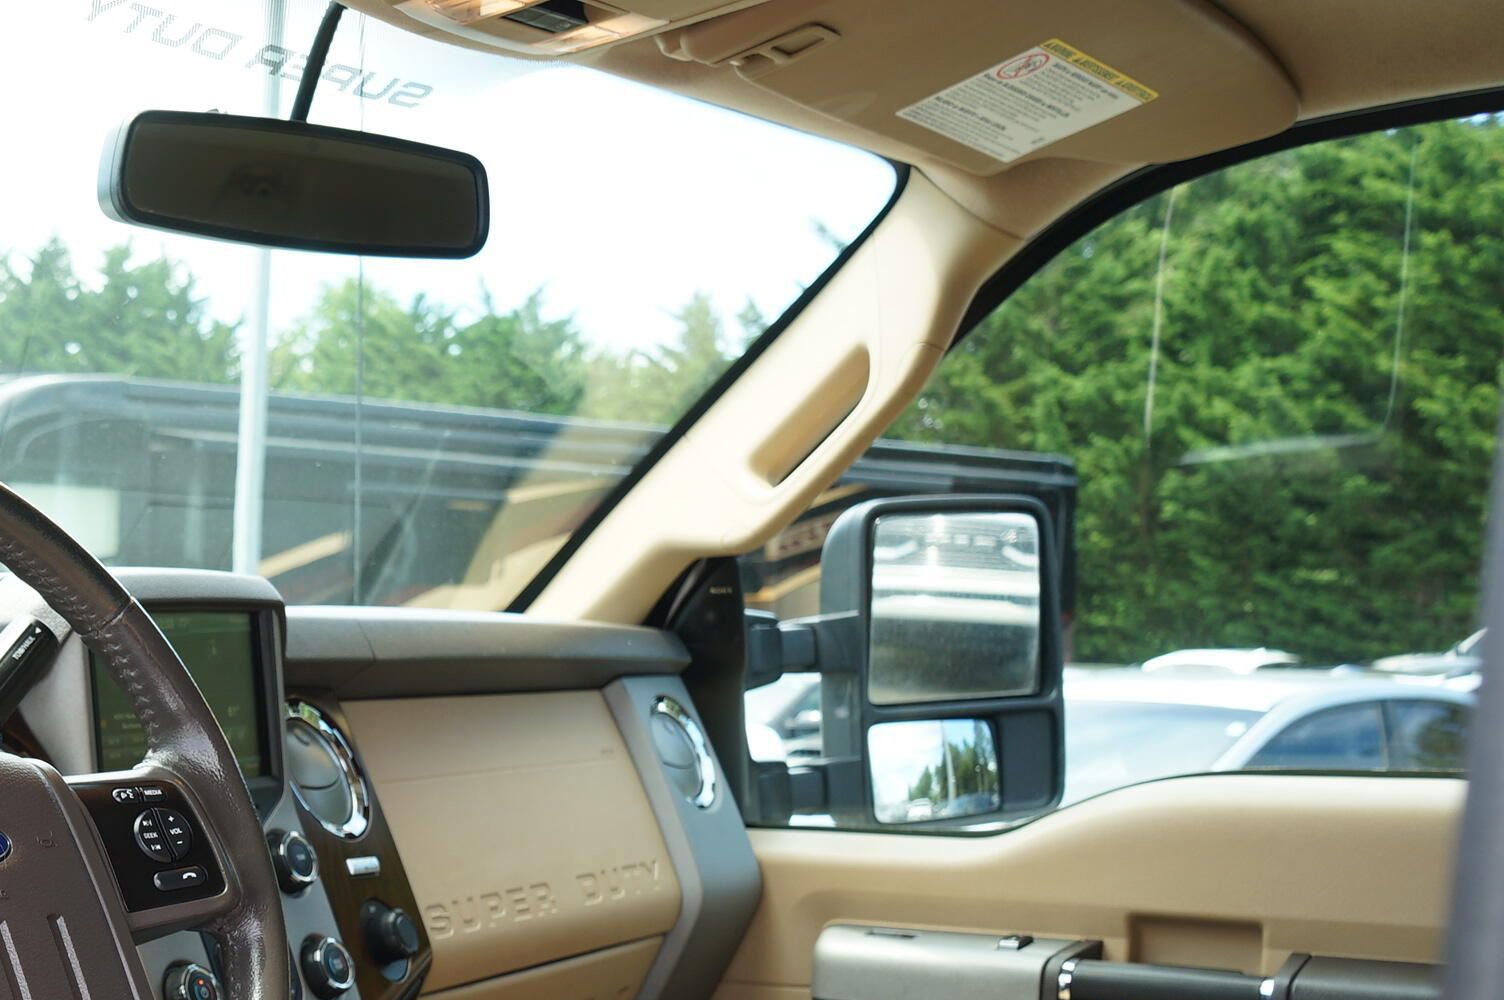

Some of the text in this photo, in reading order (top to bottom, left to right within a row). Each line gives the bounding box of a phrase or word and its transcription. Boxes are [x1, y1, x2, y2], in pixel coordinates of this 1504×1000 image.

[169, 827, 183, 836] VOL
[425, 860, 660, 940] SUPER DUTY
